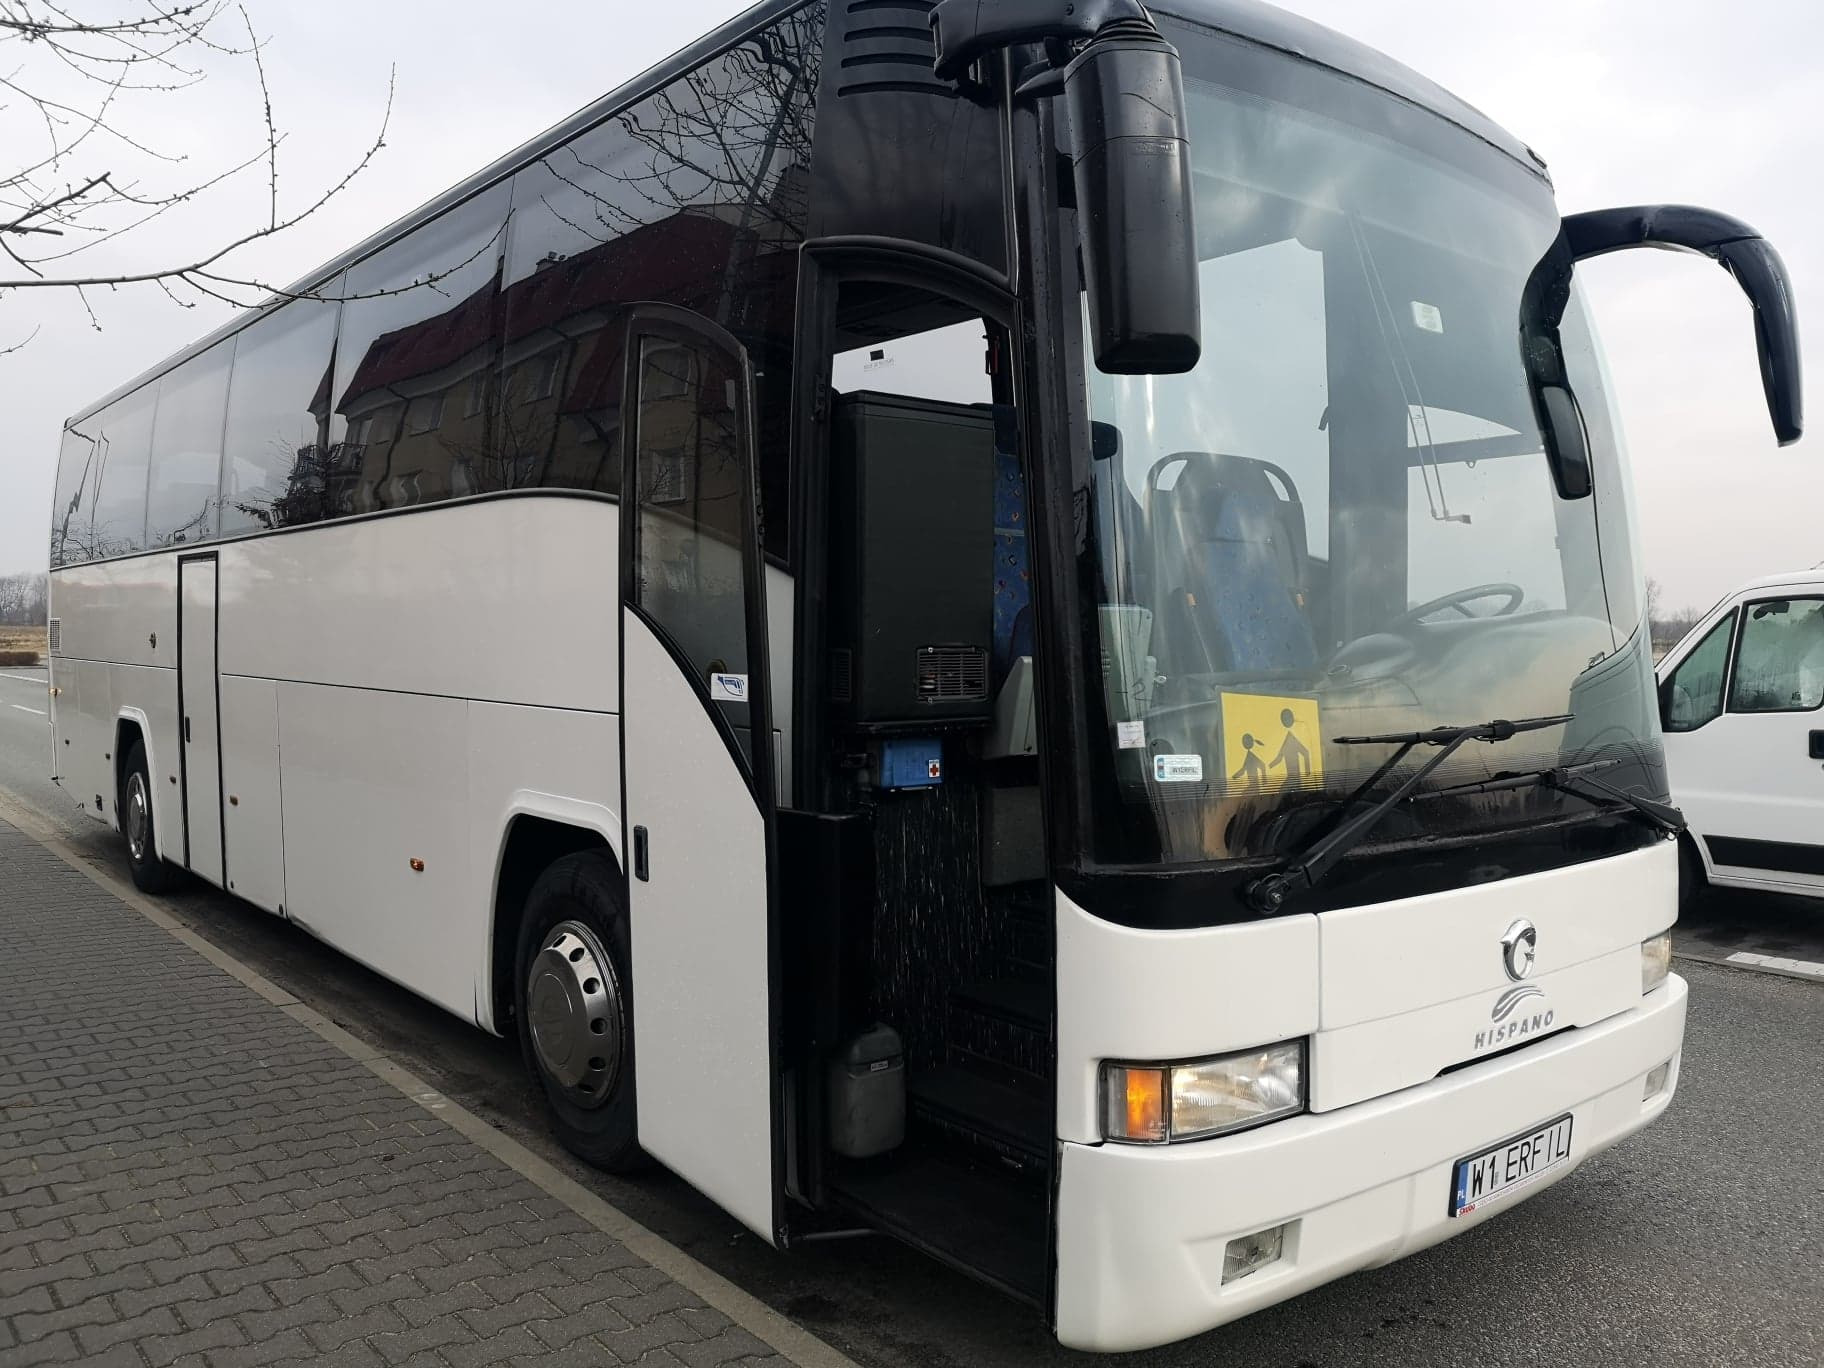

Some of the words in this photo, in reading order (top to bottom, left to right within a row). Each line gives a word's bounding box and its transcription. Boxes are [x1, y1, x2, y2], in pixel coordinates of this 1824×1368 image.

[1474, 1010, 1553, 1049] HISPANO
[1472, 1155, 1496, 1198] W1
[1505, 1125, 1565, 1182] ERFIL
[1457, 1189, 1465, 1201] PL
